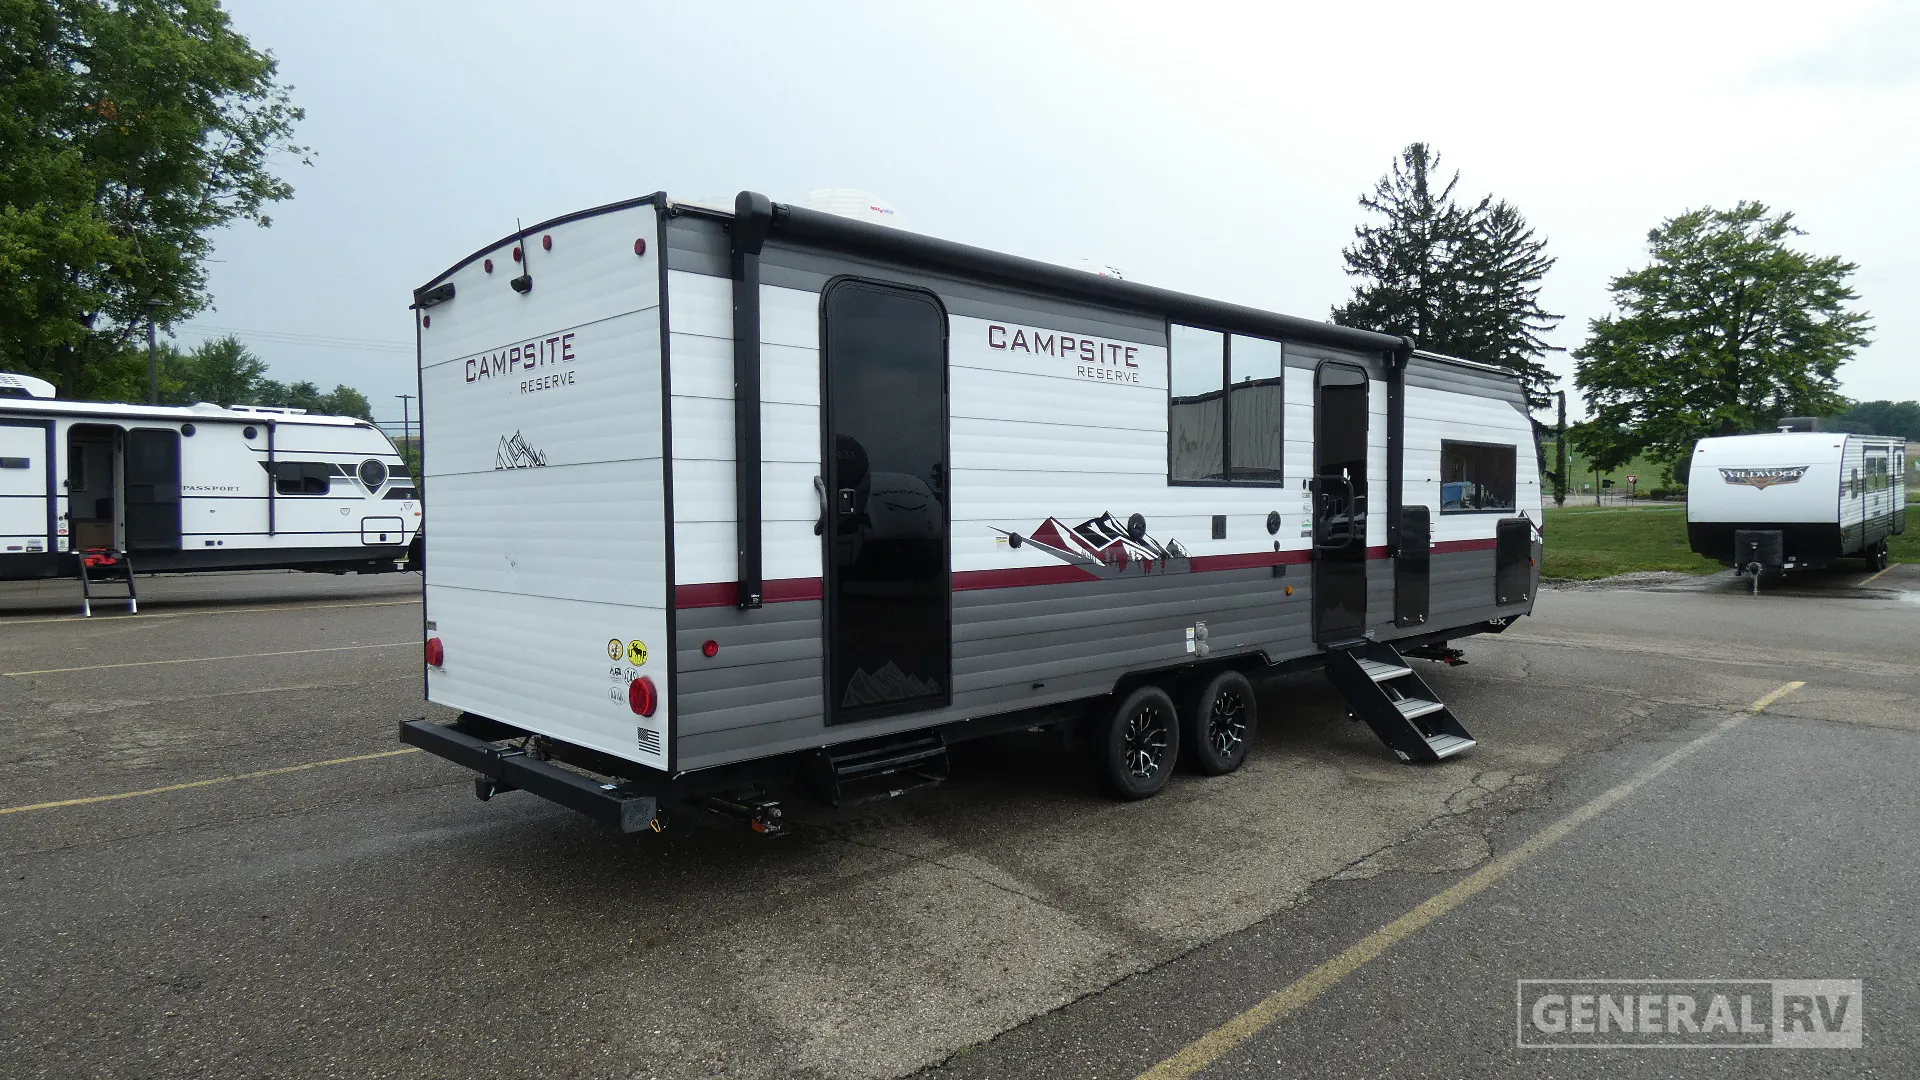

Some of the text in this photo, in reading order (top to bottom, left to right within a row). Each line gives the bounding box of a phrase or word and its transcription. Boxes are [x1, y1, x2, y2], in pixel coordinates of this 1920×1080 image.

[465, 332, 575, 383] CAMPSITE
[988, 324, 1139, 368] CAMPSITE
[520, 370, 575, 394] RESERVE
[1077, 365, 1139, 383] RESERVE
[1720, 469, 1804, 478] WILDWOOD
